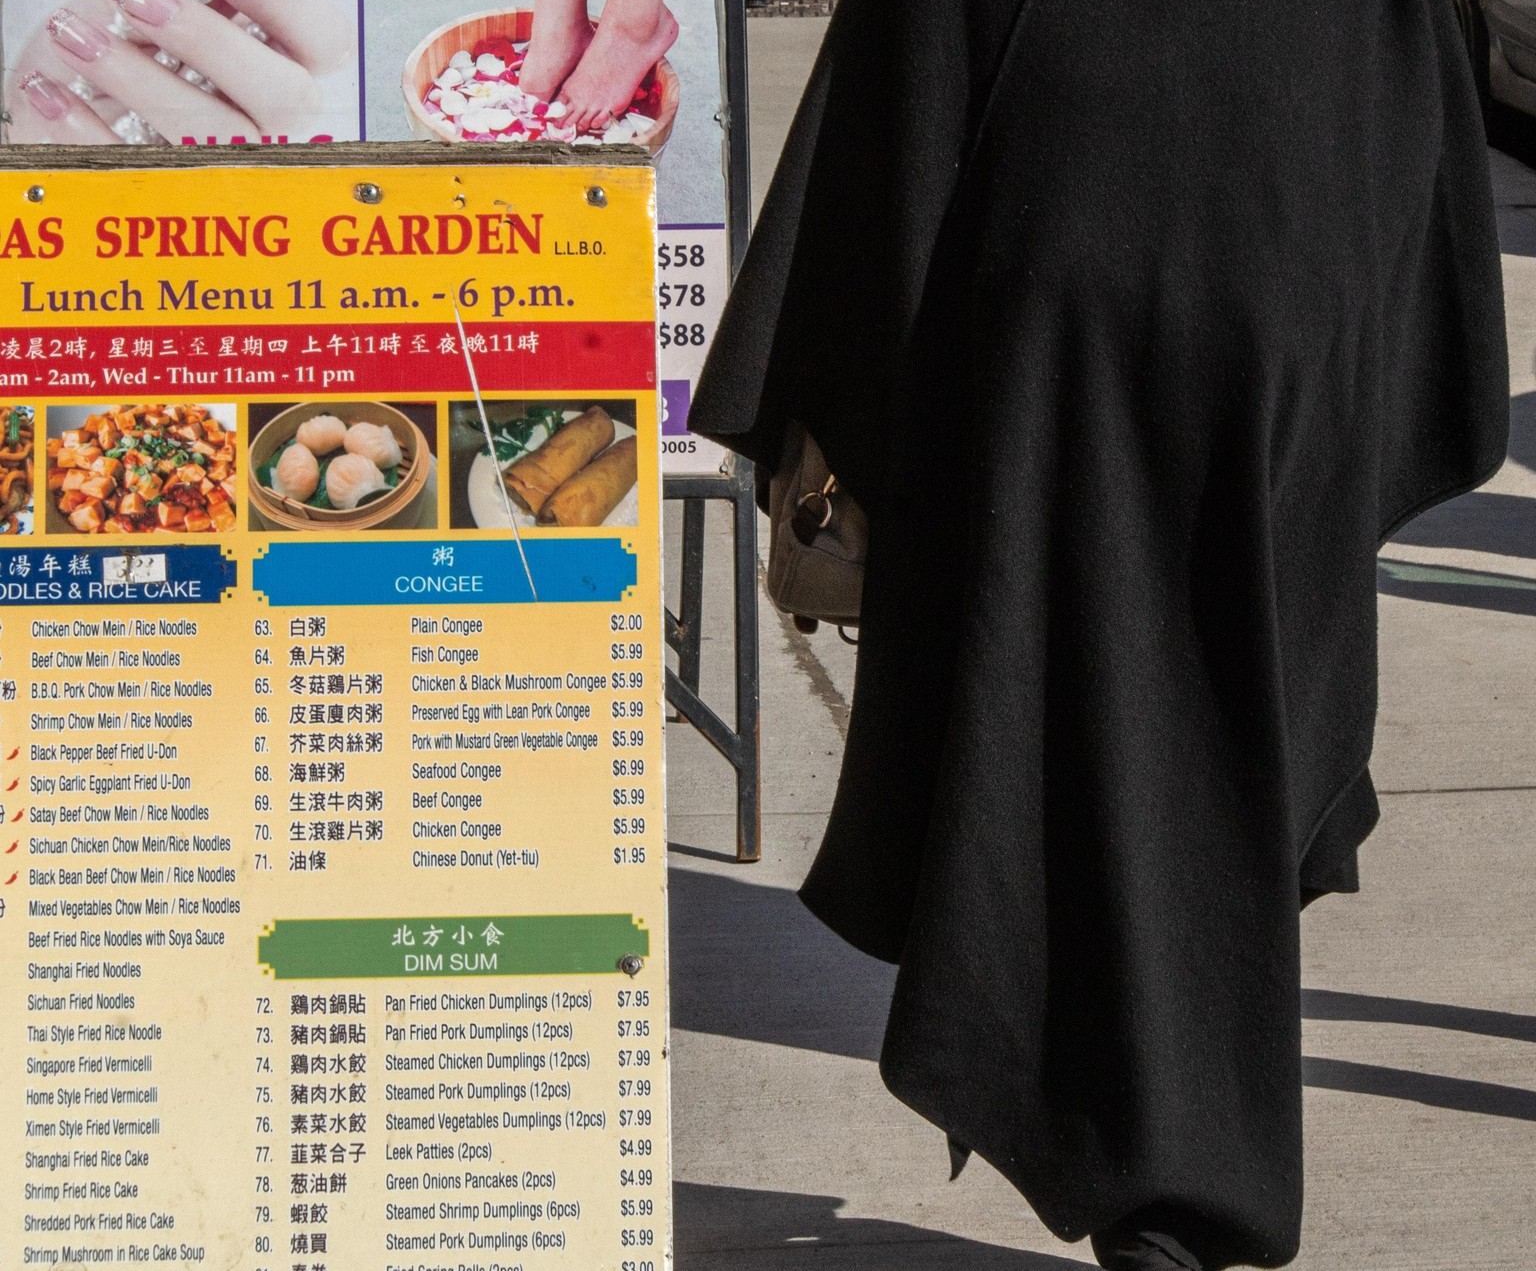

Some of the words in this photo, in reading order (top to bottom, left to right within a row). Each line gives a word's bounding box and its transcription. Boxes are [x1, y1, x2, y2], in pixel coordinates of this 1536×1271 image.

[95, 216, 291, 259] SPRING
[321, 213, 544, 257] GARDEN
[554, 240, 607, 256] L.L.B.O.
[658, 243, 705, 271] $58
[20, 279, 144, 313] Lunch
[157, 280, 274, 311] Menu
[286, 279, 327, 309] 11
[339, 286, 420, 310] a.m.
[457, 278, 479, 309] 6
[490, 286, 575, 318] p.m.
[658, 281, 706, 310] $78
[659, 322, 706, 350] $88
[47, 368, 97, 389] 2am,
[102, 366, 148, 385] Wed
[166, 366, 219, 385] Thur
[223, 366, 276, 384] 11am
[294, 365, 316, 383] 11
[322, 369, 356, 388] pm
[431, 544, 456, 568] 粥
[67, 583, 83, 600] &
[88, 581, 138, 599] RICE
[143, 580, 202, 599] CAKE
[394, 575, 484, 594] CONGEE
[254, 619, 273, 637] 63.
[290, 616, 326, 638] 白粥
[411, 616, 439, 634] Plain
[441, 616, 483, 638] Congee
[610, 613, 643, 632] $2.00
[254, 648, 273, 666] 64.
[289, 645, 345, 666] 魚片粥
[411, 645, 435, 663] Fish
[437, 645, 479, 666] Congee
[610, 642, 643, 661] $5.99
[30, 744, 58, 762] Black
[59, 744, 94, 765] Pepper
[95, 744, 119, 761] Beef
[120, 742, 145, 760] Fried
[146, 741, 178, 760] U-Don
[254, 764, 273, 783] 68.
[288, 761, 345, 783] 海鮮粥
[411, 762, 457, 780] Seafood
[460, 762, 502, 782] Congee
[612, 758, 645, 777] $6.99
[254, 853, 273, 870] 71.
[288, 850, 327, 871] 油條
[412, 850, 457, 868] Chinese
[460, 849, 494, 867] Donut
[495, 848, 540, 870] (Yet-tiu)
[613, 845, 646, 865] $1.95
[391, 921, 505, 948] 北方小食
[27, 961, 73, 983] Shanghai
[75, 961, 100, 979] Fried
[102, 961, 142, 979] Noodles
[404, 953, 443, 972] DIM
[449, 952, 498, 971] SUM
[255, 997, 274, 1014] 72.
[385, 994, 406, 1012] Pan
[409, 994, 438, 1012] Fried
[440, 993, 486, 1011] Chicken
[488, 992, 549, 1013] Dumplings
[551, 990, 593, 1012] (12pcs)
[617, 989, 650, 1009] $7.95
[26, 1057, 76, 1078] Singapore
[78, 1056, 103, 1074] Fried
[104, 1054, 153, 1073] Vermicelli
[255, 1146, 274, 1163] 77.
[385, 1143, 414, 1161] Leek
[416, 1142, 455, 1160] Patties
[457, 1141, 493, 1163] (2pcs)
[619, 1138, 653, 1158] $4.99
[255, 1175, 273, 1193] 78.
[385, 1173, 419, 1191] Green
[422, 1172, 462, 1191] Onions
[464, 1171, 519, 1190] Pancakes
[521, 1170, 556, 1192] (2pcs)
[619, 1168, 653, 1187] $4.99
[24, 1214, 71, 1232] Shredded
[73, 1214, 96, 1232] Pork
[98, 1213, 123, 1231] Fried
[125, 1212, 147, 1230] Rice
[149, 1212, 175, 1230] Cake
[255, 1236, 273, 1253] 80.
[290, 1233, 328, 1254] 燒買
[385, 1232, 436, 1251] Steamed
[439, 1232, 466, 1250] Pork
[468, 1231, 529, 1253] Dumplings
[531, 1230, 566, 1251] (6pcs)
[620, 1228, 654, 1247] $5.99
